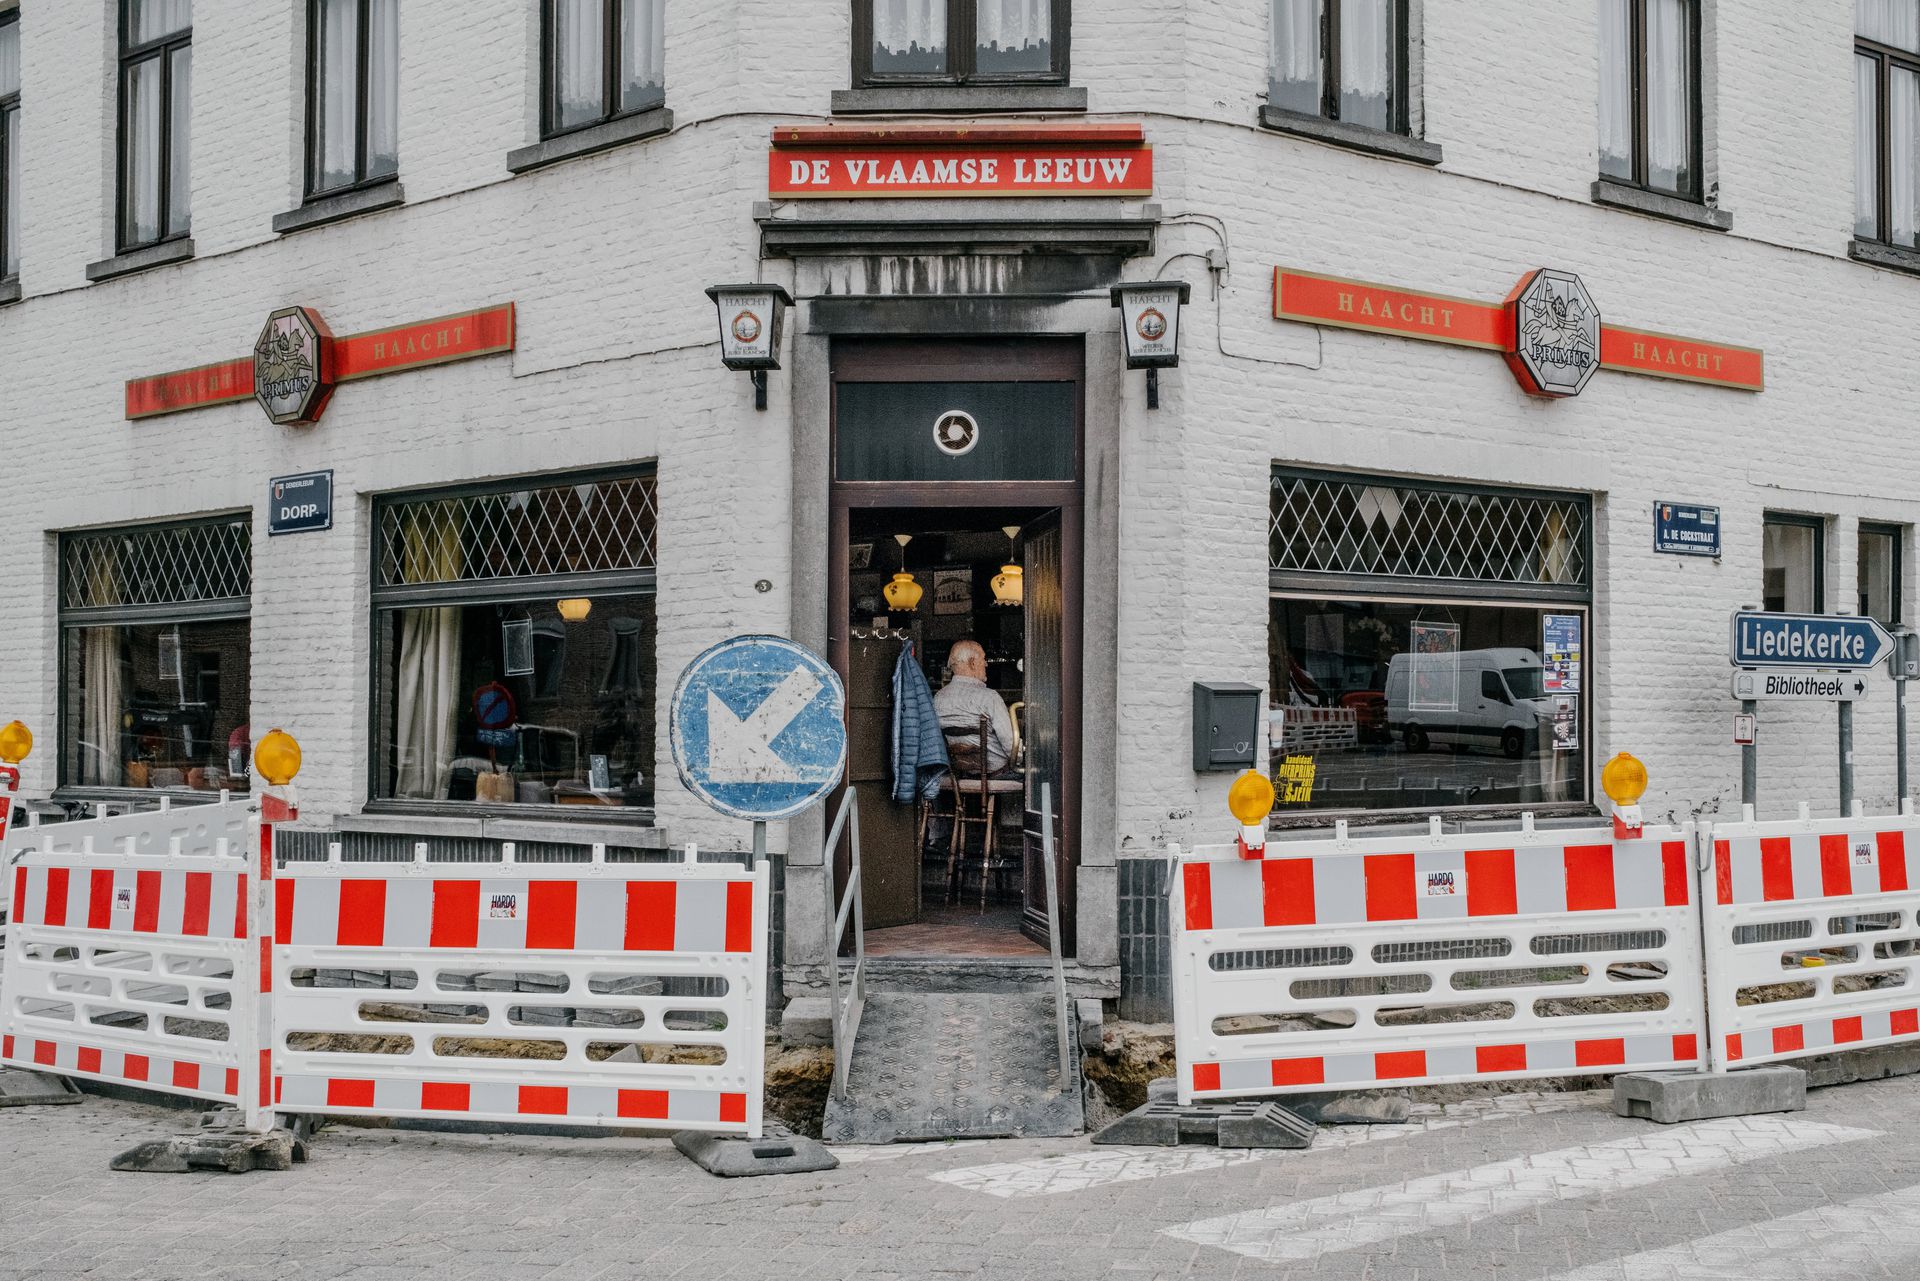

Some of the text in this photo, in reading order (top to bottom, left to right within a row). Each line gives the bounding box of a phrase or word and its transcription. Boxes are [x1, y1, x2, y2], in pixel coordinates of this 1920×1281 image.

[789, 157, 1132, 185] DE VLAAMSE LEEUW
[1337, 291, 1454, 328] HAACHT
[374, 326, 464, 361] HAACHT
[1532, 343, 1591, 369] PRIMUS
[1632, 341, 1723, 371] HAACHT
[263, 375, 311, 400] PRIMUS
[281, 503, 317, 520] DORP
[1663, 529, 1714, 543] A. DE COCKSTRAAT
[1742, 621, 1865, 660] Liedekerke
[1765, 675, 1843, 696] Bibliotheek
[1279, 763, 1316, 779] BIERPRINS
[1428, 871, 1454, 887] HARDO
[491, 894, 516, 909] HARDO
